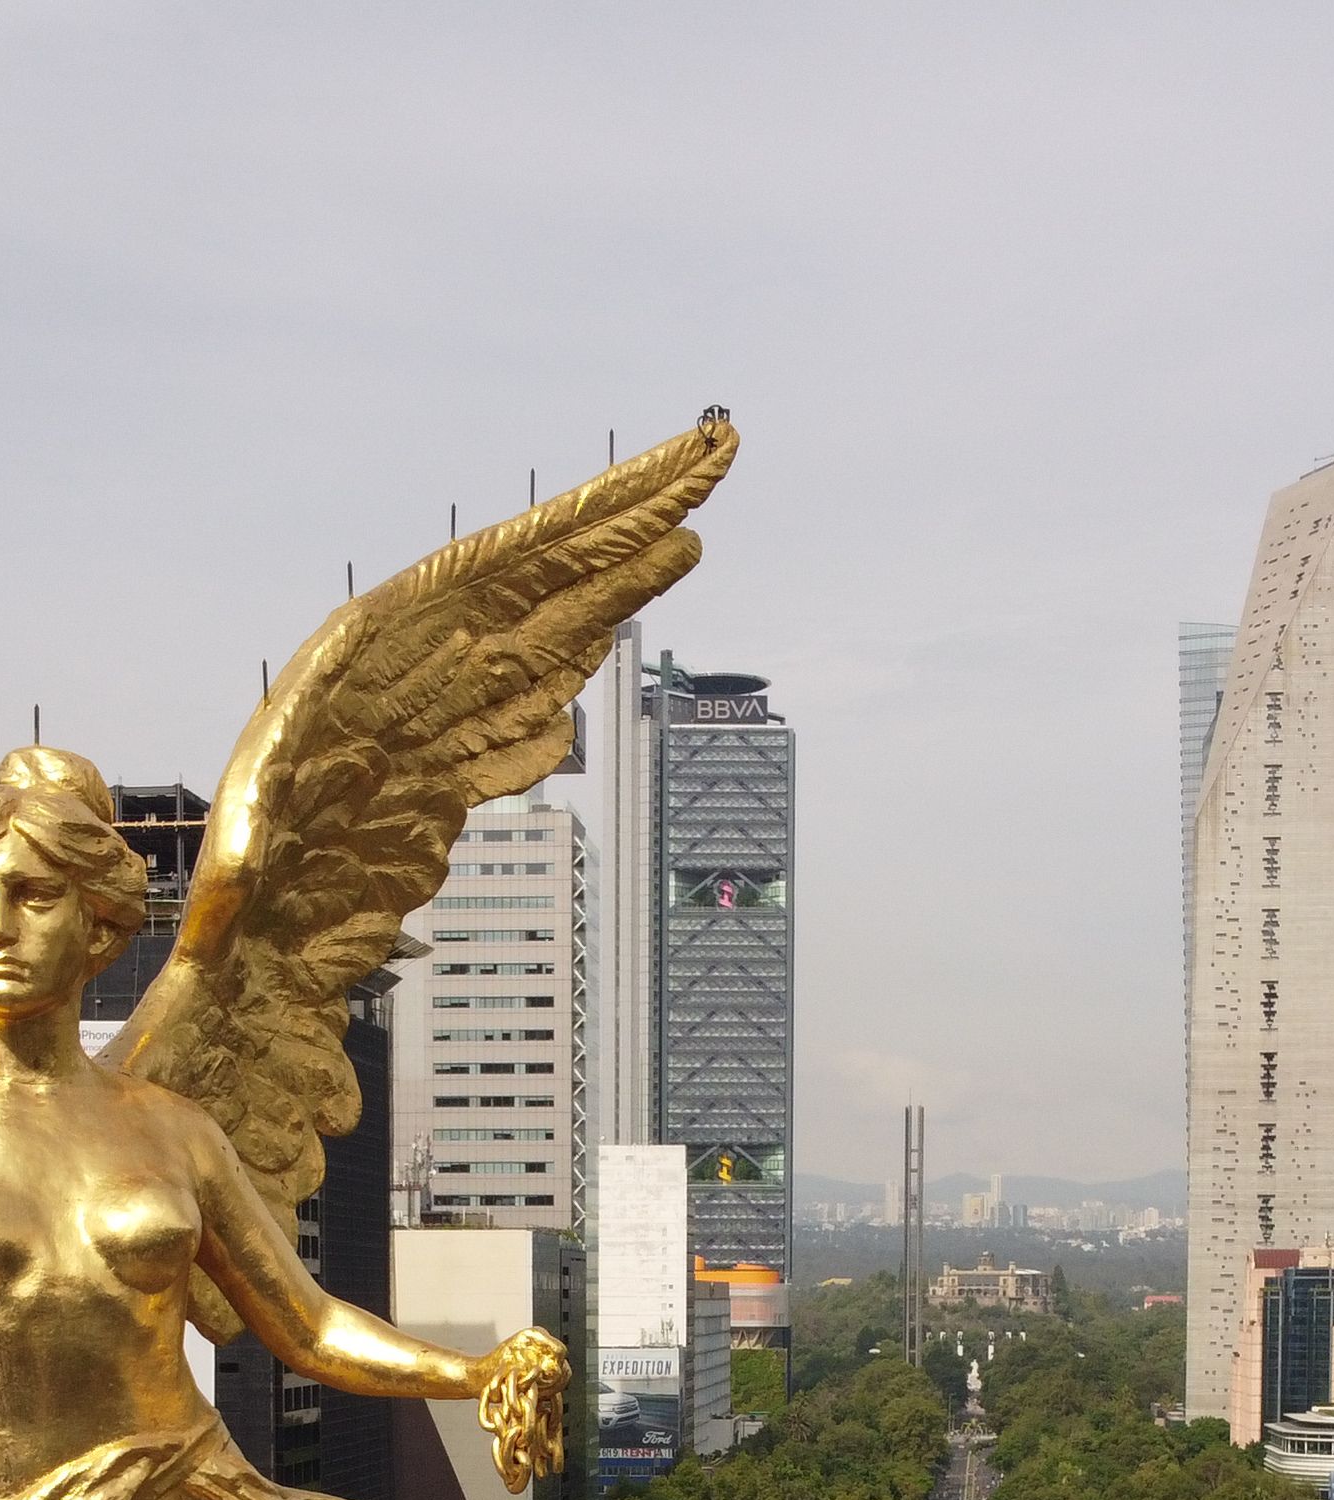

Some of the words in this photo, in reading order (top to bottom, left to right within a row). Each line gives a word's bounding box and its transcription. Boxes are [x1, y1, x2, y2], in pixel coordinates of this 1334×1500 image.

[697, 699, 765, 719] BBVA
[602, 1360, 673, 1375] EXPEDITION
[642, 1431, 673, 1445] Ford
